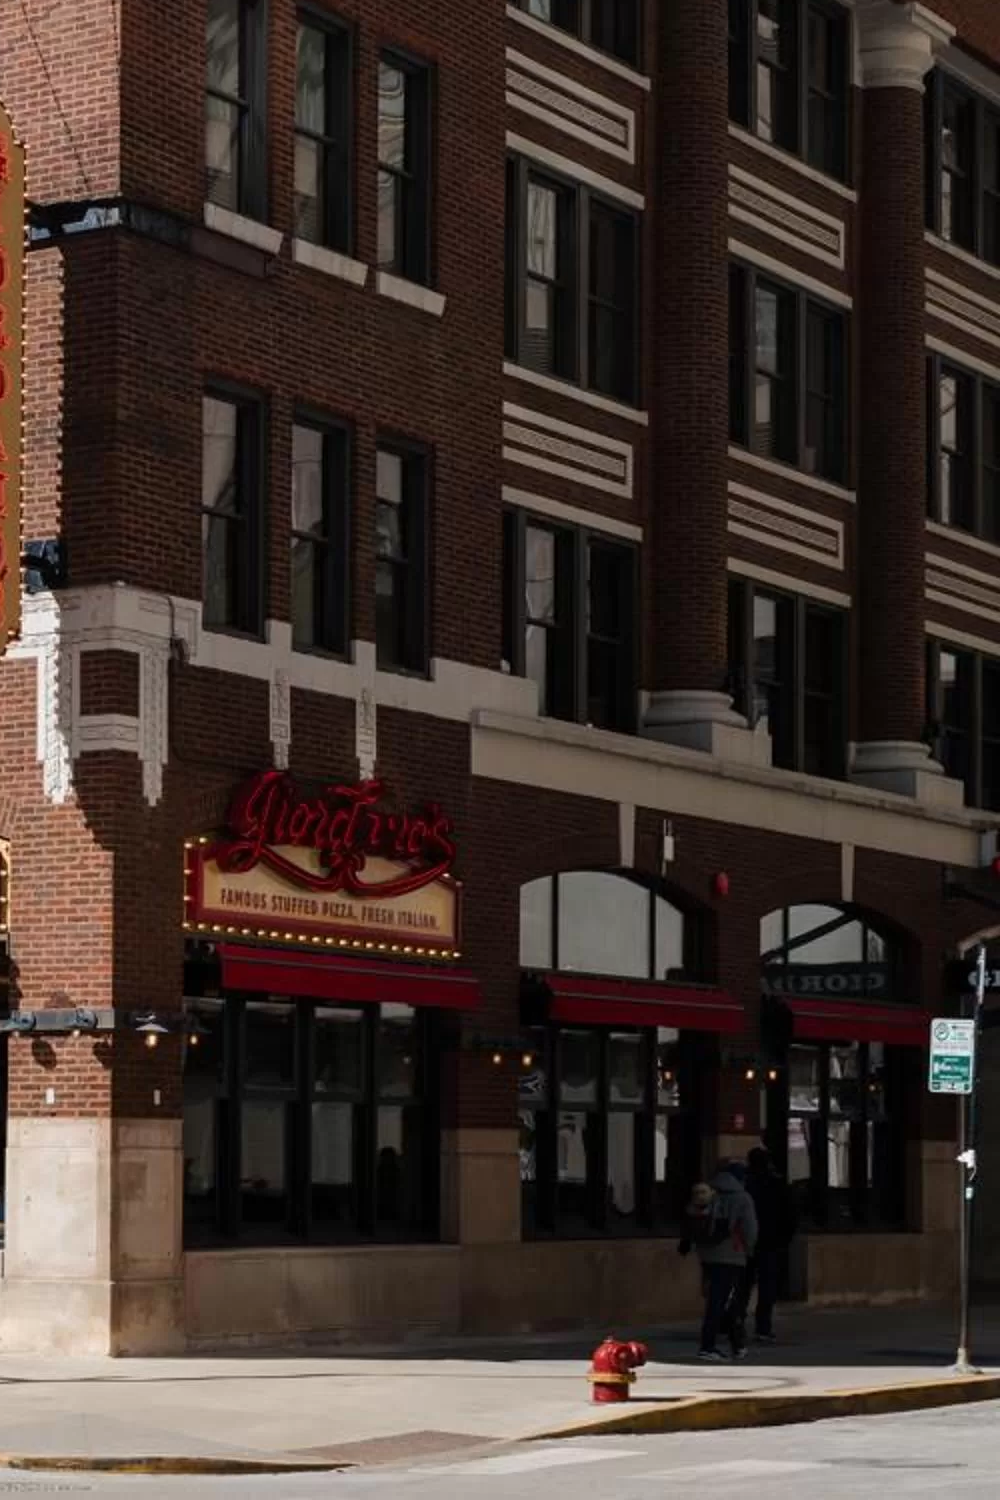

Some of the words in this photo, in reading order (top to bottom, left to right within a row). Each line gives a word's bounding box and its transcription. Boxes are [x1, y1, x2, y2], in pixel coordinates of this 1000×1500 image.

[221, 887, 267, 910] FAMOUS
[271, 894, 318, 916] STUFFED
[361, 904, 395, 925] FRESH
